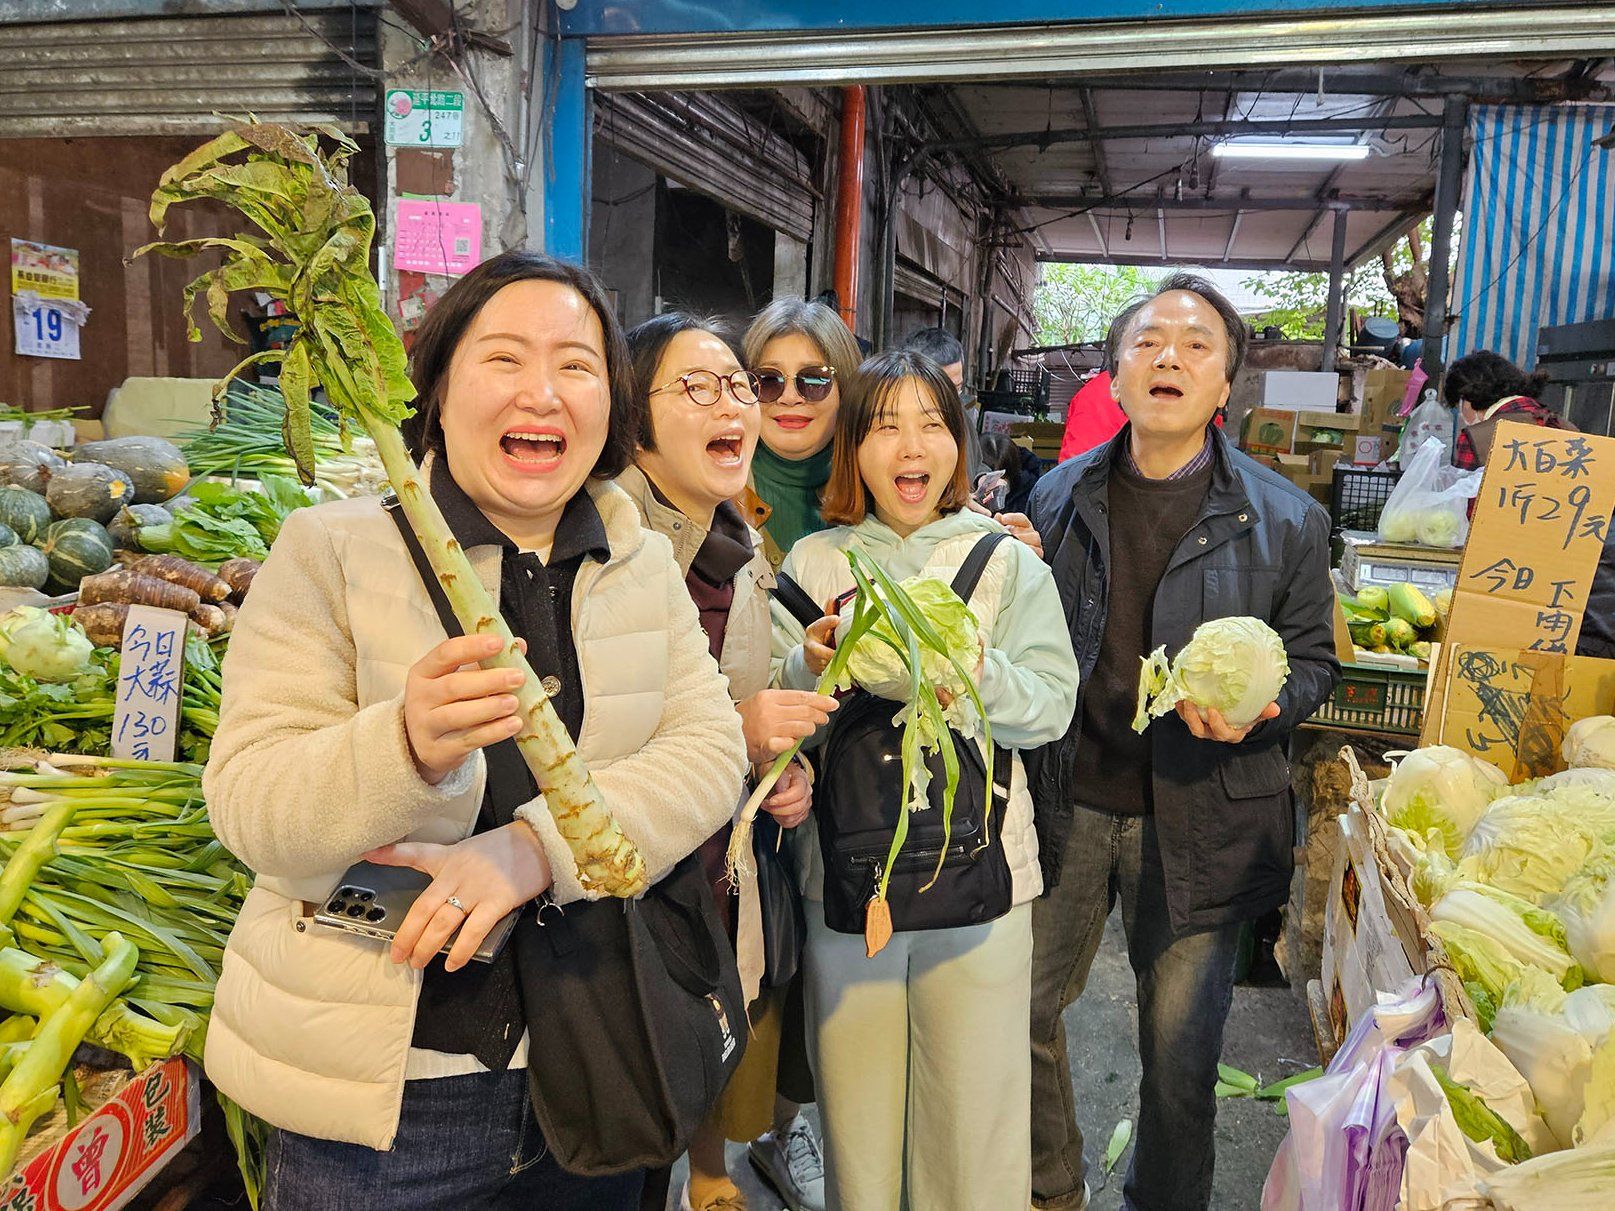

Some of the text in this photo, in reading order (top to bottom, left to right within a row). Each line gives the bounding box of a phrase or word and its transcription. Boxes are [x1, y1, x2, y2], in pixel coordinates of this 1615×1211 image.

[420, 120, 432, 142] 3
[32, 307, 62, 342] 19
[1469, 558, 1534, 593] 今日
[125, 624, 175, 662] 今日
[123, 659, 179, 705] 大蒜
[118, 711, 167, 743] 130
[144, 1072, 172, 1146] 包裝
[71, 1126, 110, 1196] 曾
